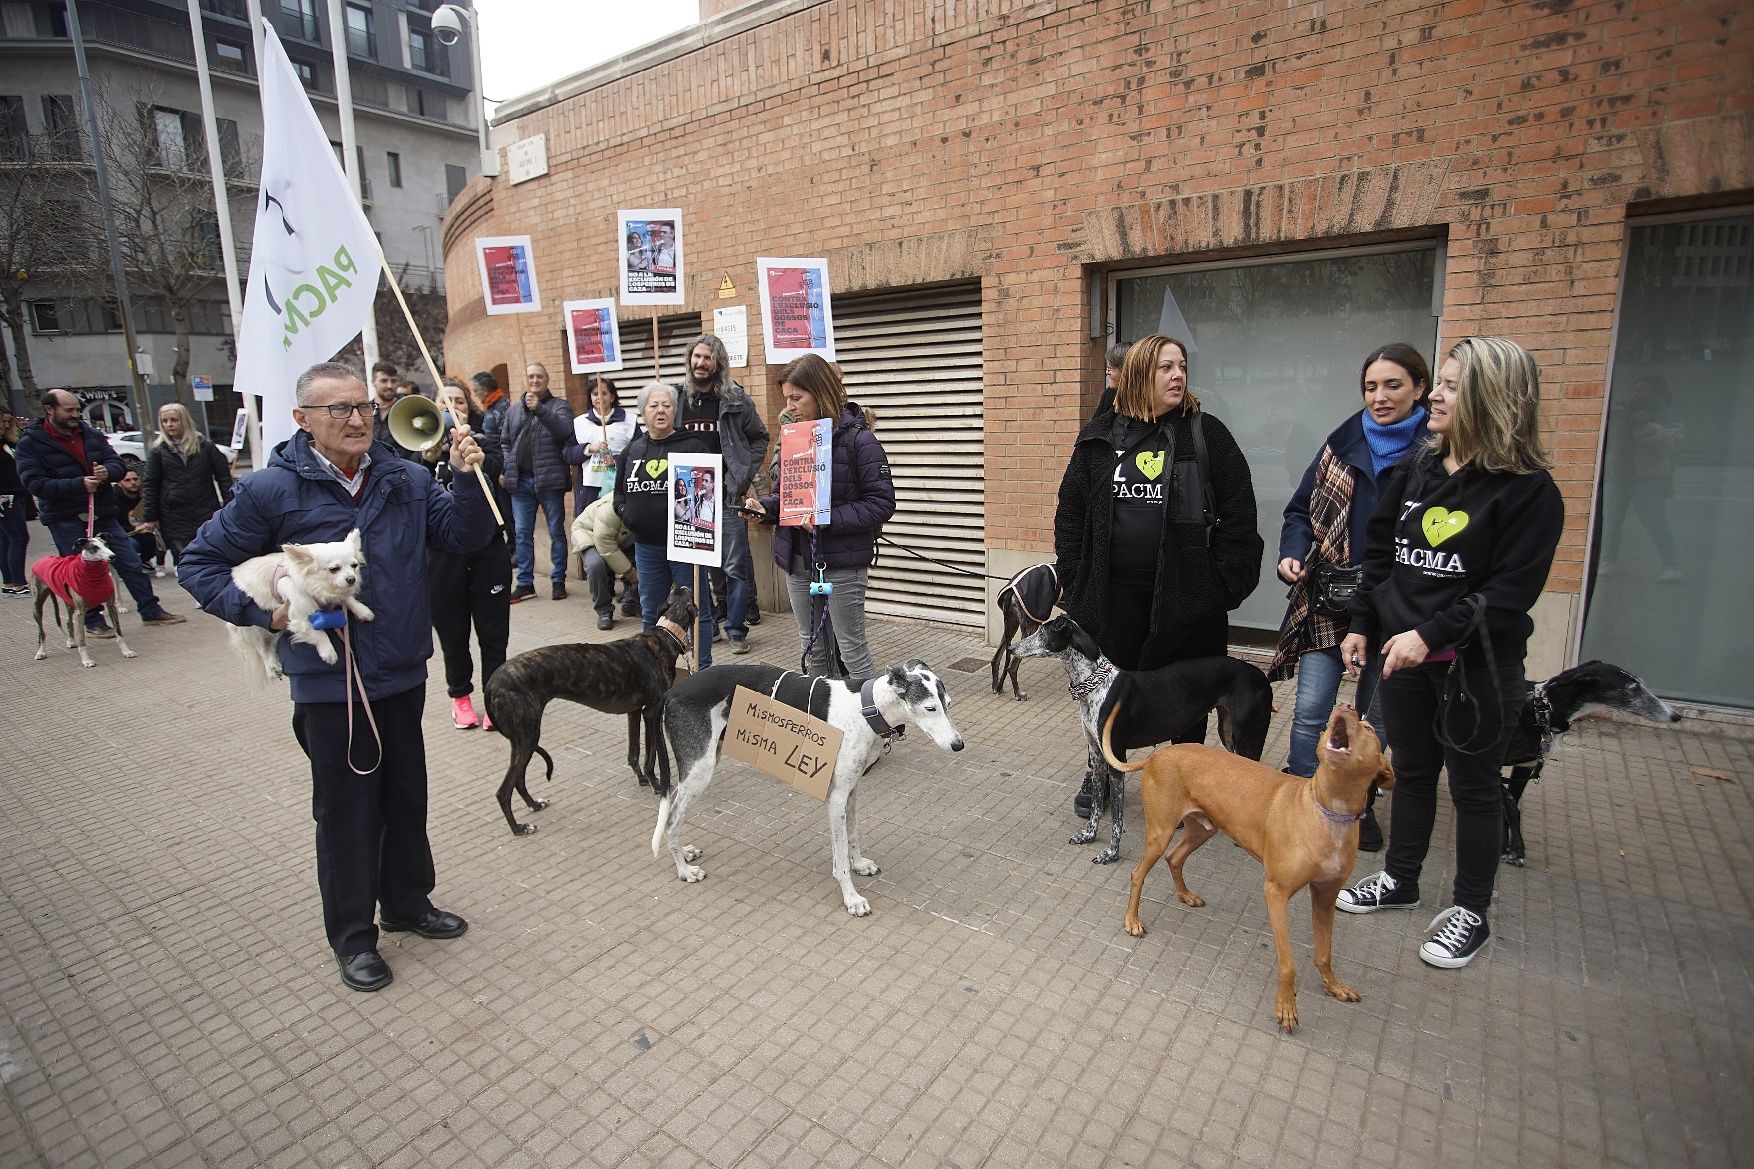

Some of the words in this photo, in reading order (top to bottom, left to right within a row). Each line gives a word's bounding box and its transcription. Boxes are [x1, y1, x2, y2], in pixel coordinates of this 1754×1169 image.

[771, 295, 806, 303] CONTRA
[783, 457, 815, 467] CONTRA
[783, 474, 803, 483] DELS
[783, 481, 814, 491] GOSSOS
[1112, 483, 1163, 499] PACM
[782, 491, 793, 499] DE
[784, 745, 828, 779] LEY
